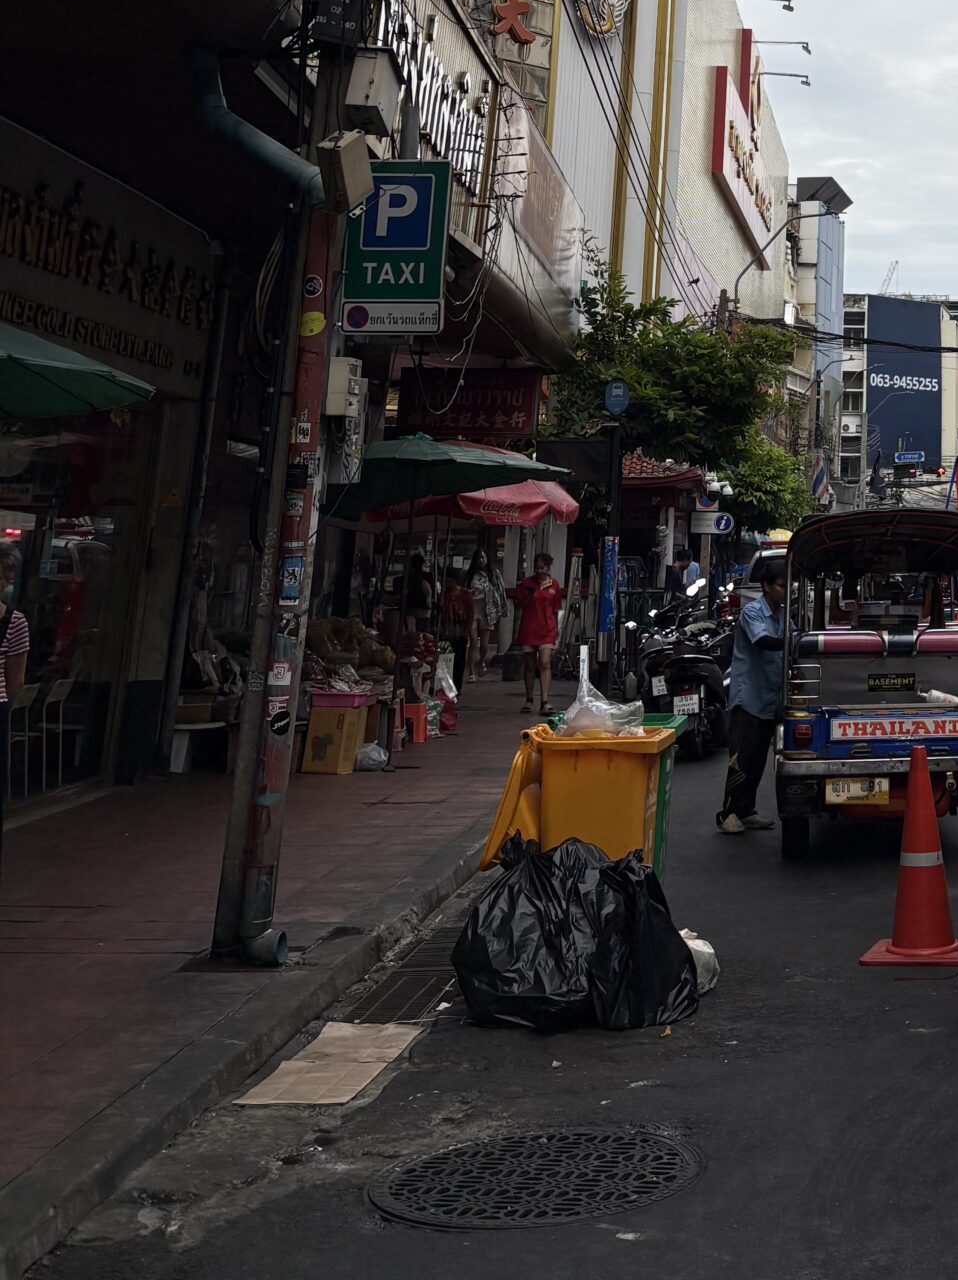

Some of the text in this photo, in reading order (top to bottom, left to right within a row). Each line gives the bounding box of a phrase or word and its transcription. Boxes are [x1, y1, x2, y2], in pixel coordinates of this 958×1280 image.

[375, 184, 419, 237] P
[362, 262, 425, 285] TAXI
[869, 373, 940, 392] 063-9455255
[868, 677, 915, 686] BASEMENT
